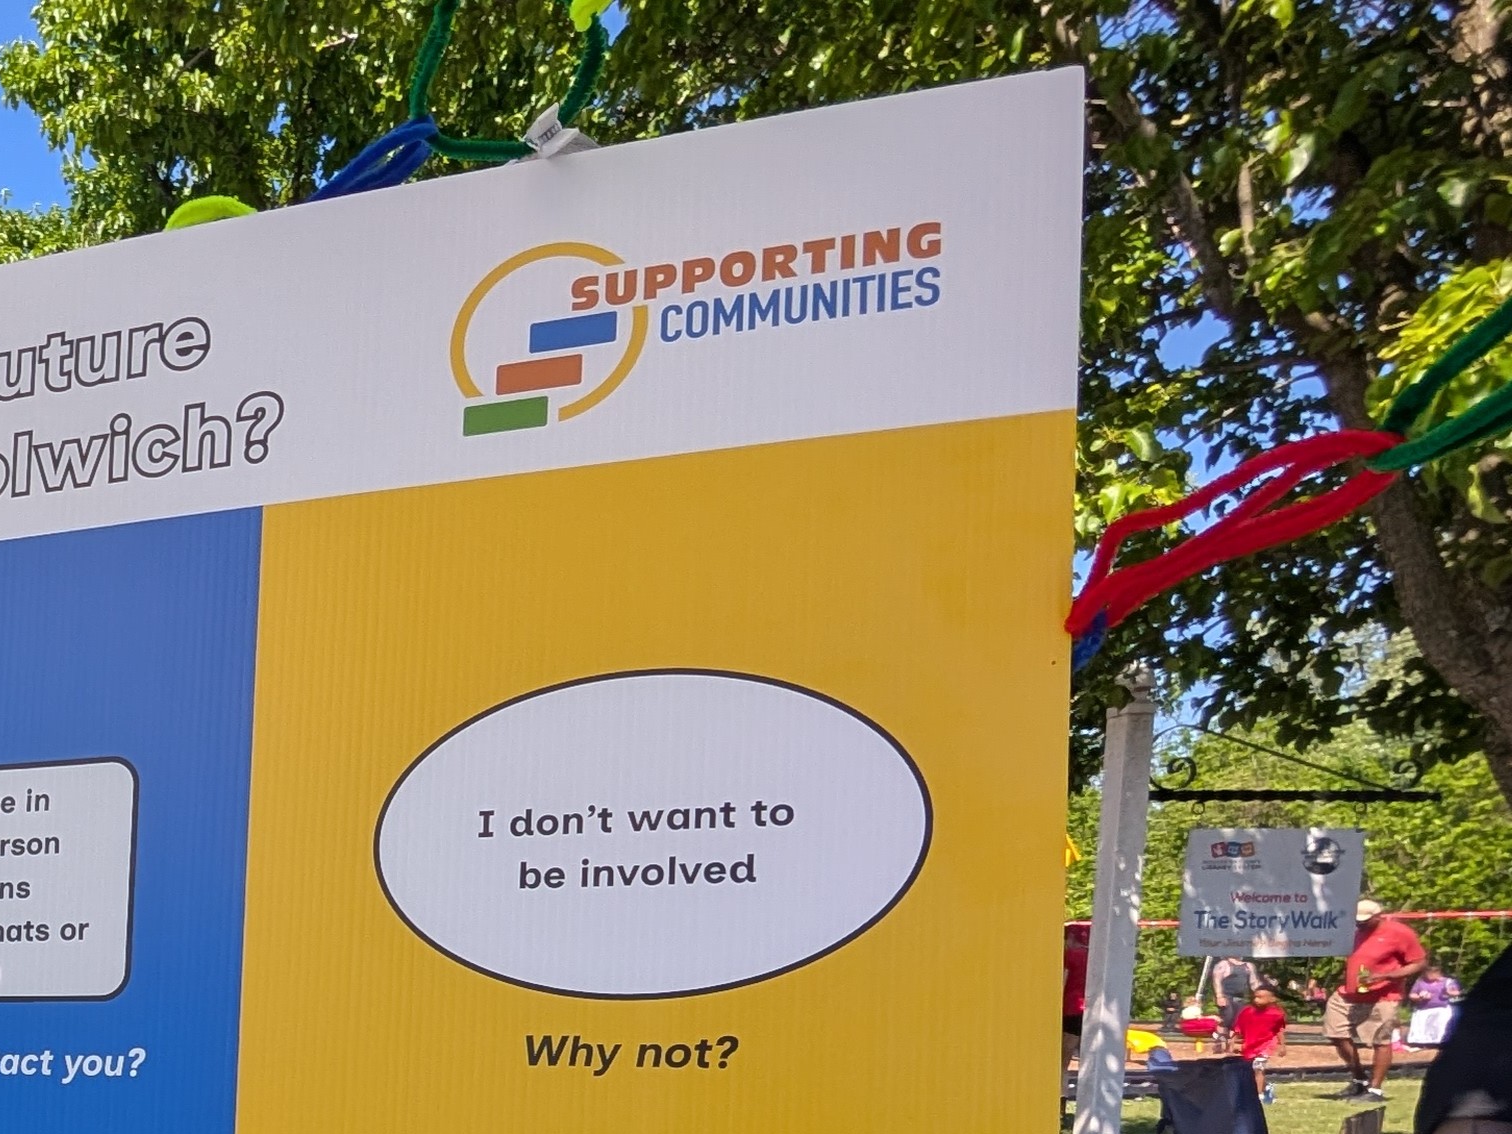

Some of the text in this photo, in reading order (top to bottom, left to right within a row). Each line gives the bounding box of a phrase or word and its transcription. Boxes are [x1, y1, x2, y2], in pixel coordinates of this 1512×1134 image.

[571, 221, 942, 312] SUPPORTING
[659, 266, 941, 344] COMMUNITIES
[26, 788, 51, 812] in
[477, 800, 795, 839] I don't want to
[519, 853, 757, 889] be involved
[1231, 892, 1309, 904] Welcome to
[59, 921, 90, 942] or
[1194, 910, 1234, 929] The
[60, 1047, 147, 1084] you?
[524, 1034, 740, 1077] Why not?
